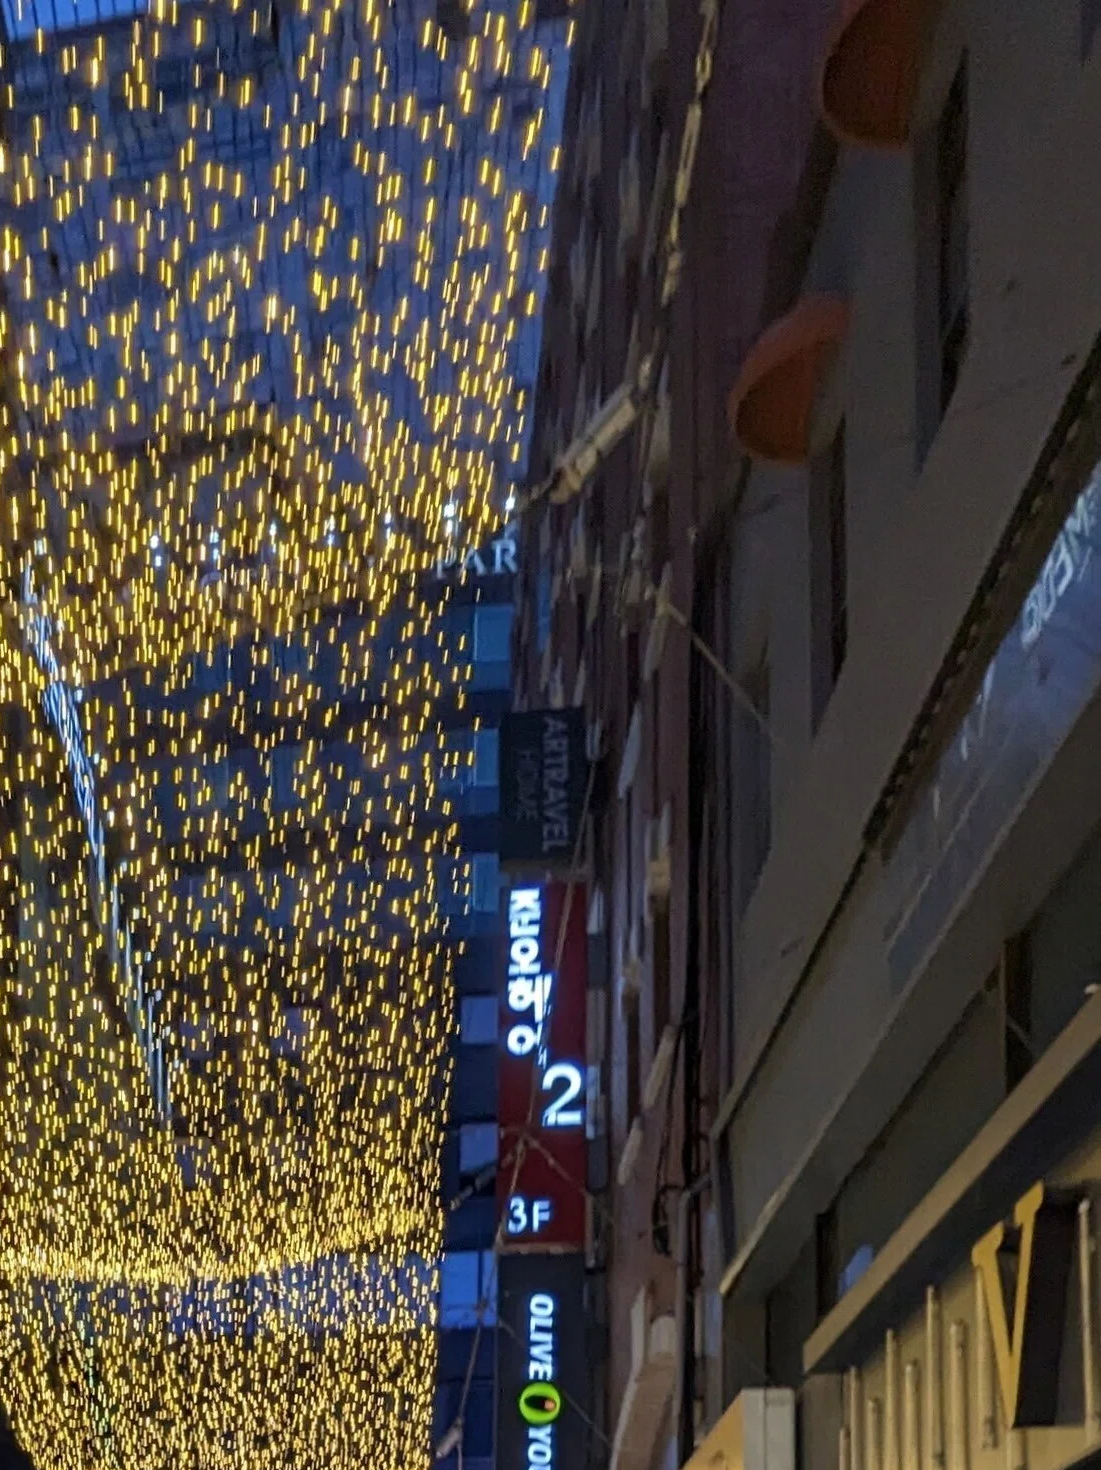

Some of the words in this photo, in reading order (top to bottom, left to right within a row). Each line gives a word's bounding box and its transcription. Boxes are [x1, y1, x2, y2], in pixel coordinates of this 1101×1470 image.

[542, 1062, 582, 1128] 2
[508, 1196, 551, 1234] 3F
[528, 1293, 554, 1381] OLIVE
